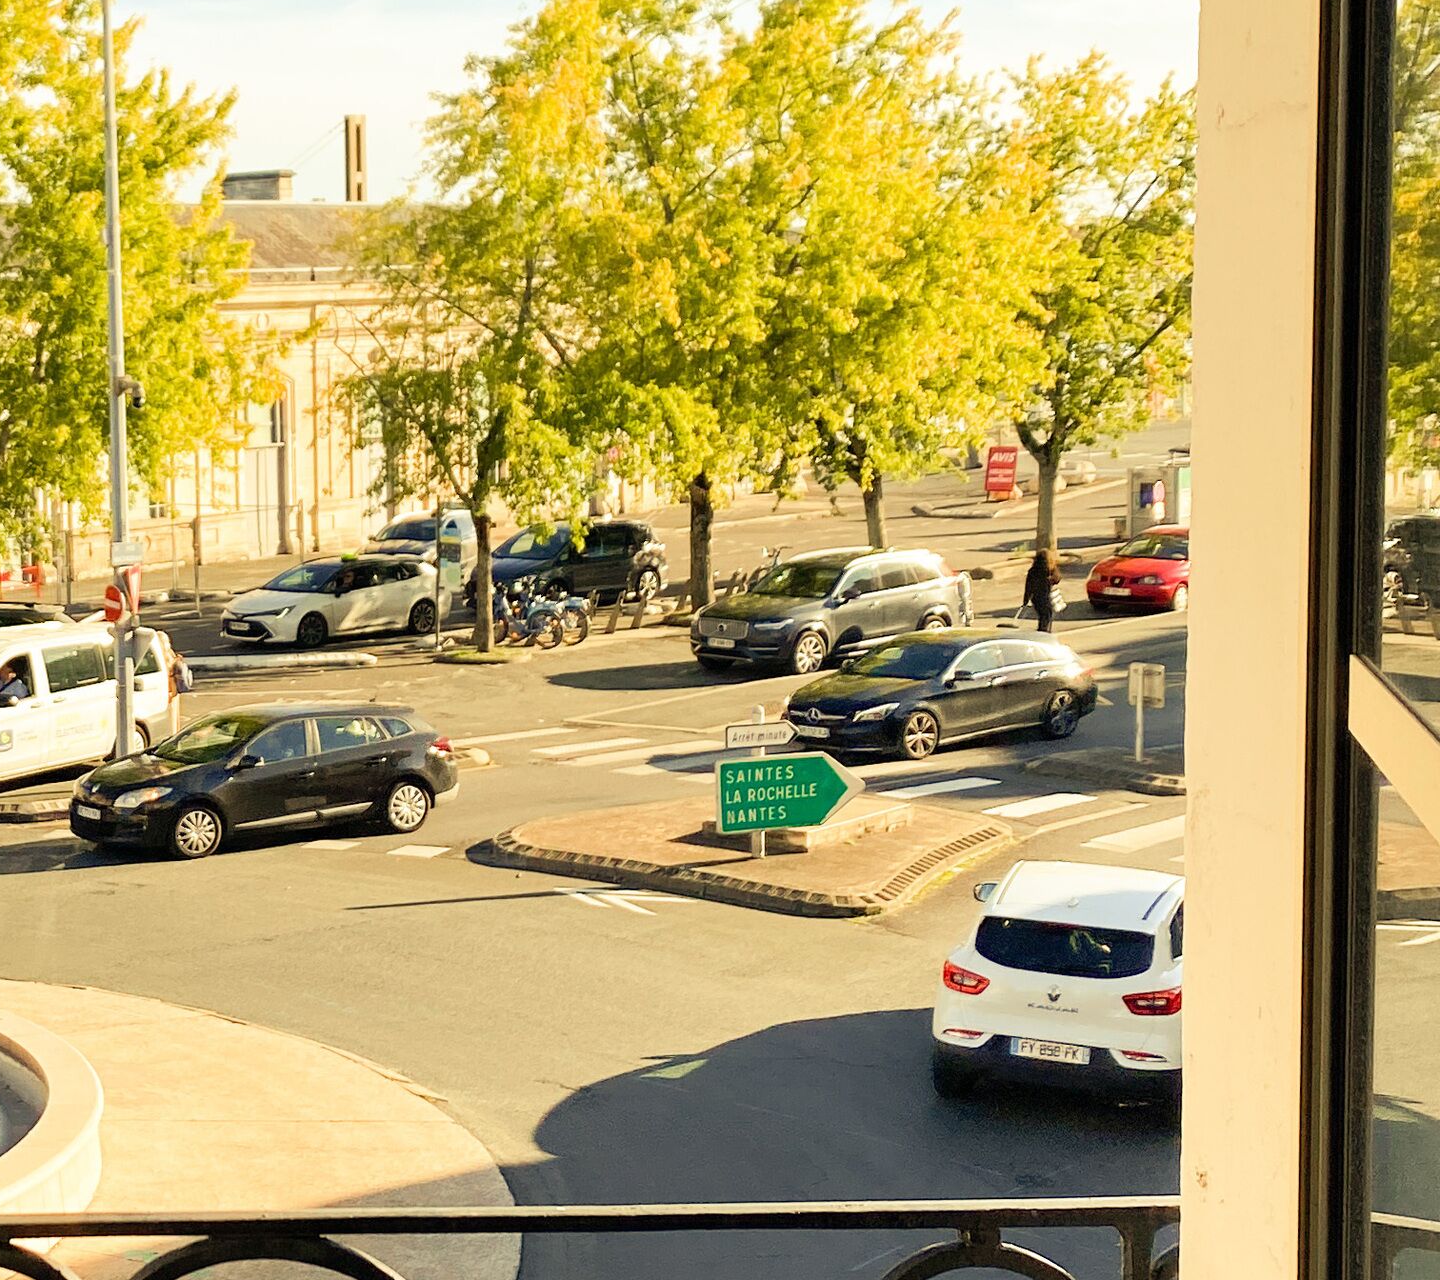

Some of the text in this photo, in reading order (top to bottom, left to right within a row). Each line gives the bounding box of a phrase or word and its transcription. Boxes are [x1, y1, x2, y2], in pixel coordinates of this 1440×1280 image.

[991, 452, 1016, 462] AVIS
[732, 732, 754, 743] Arrêt
[757, 730, 787, 742] minute
[726, 765, 794, 784] SAINTES
[726, 783, 817, 804] LA ROCHELLE
[726, 806, 787, 824] NANTES
